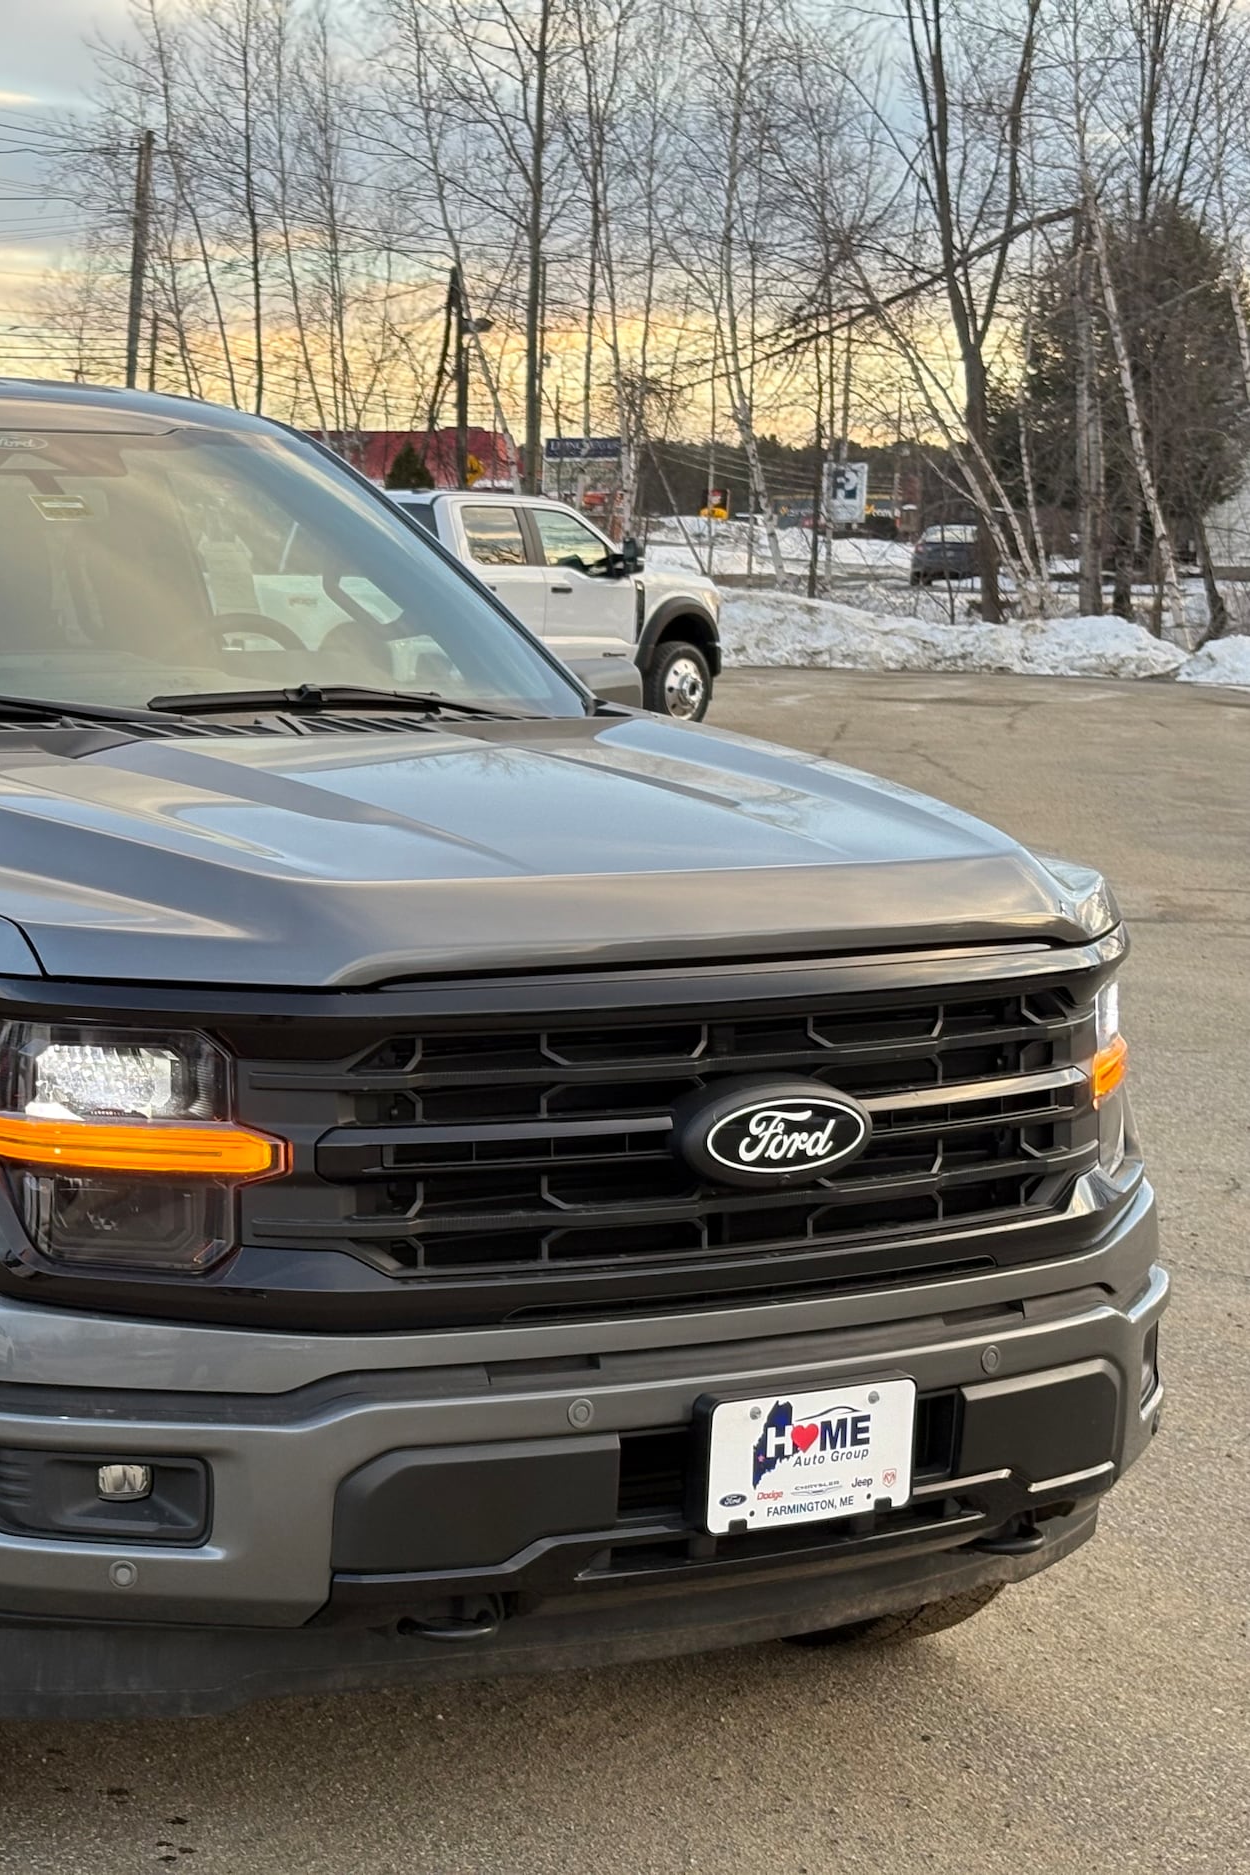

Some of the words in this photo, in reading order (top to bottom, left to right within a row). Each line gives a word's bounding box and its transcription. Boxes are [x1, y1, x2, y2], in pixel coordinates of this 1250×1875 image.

[738, 1109, 837, 1162] Ford
[793, 1454, 825, 1467] Auto
[830, 1448, 869, 1464] Group
[794, 1480, 841, 1490] CHRYSLER
[851, 1477, 873, 1488] Jeep
[756, 1490, 784, 1501] Dodge
[766, 1501, 837, 1517] FARMINGTON,
[839, 1495, 854, 1506] ME
